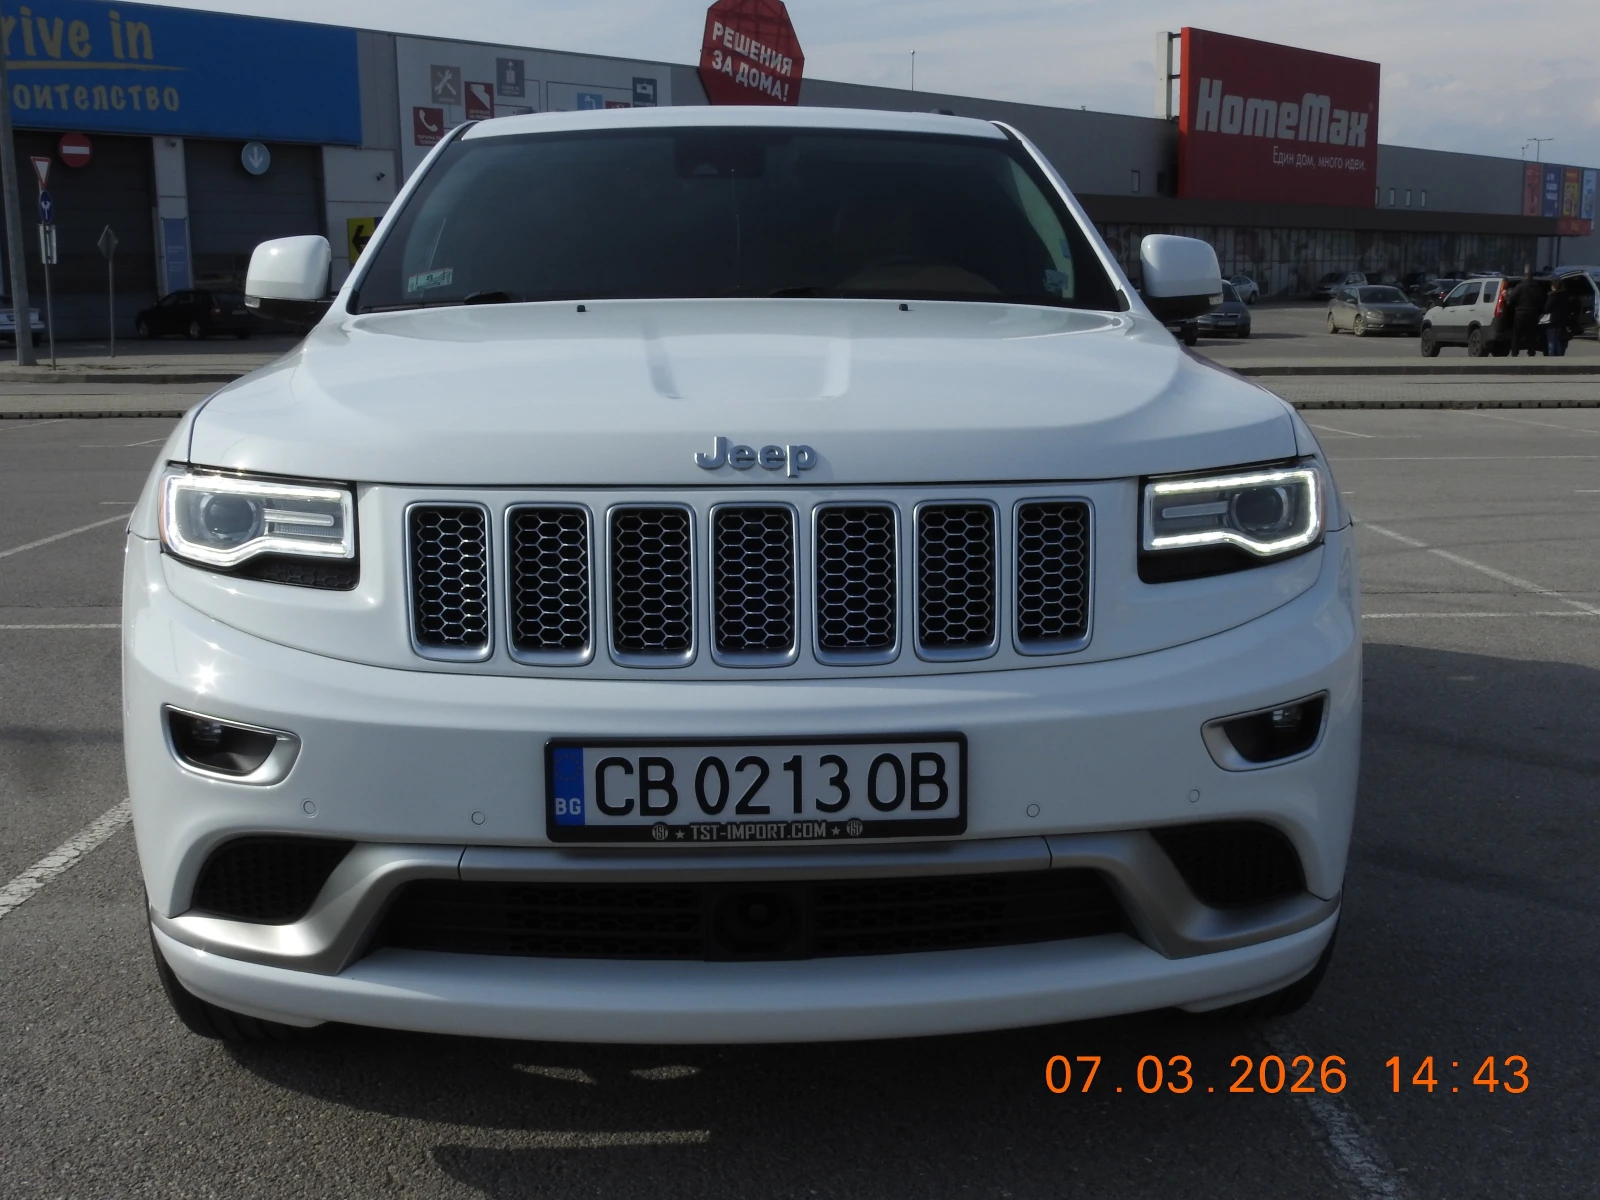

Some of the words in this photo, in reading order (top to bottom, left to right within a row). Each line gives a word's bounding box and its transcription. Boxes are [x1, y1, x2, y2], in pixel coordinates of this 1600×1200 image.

[109, 9, 154, 60] in
[712, 21, 793, 77] РЕШЕНИЯ
[712, 50, 733, 77] ЗА
[735, 61, 789, 102] ДОМА!
[1195, 77, 1369, 148] HomeMax
[1273, 146, 1294, 165] Един
[1296, 154, 1316, 170] дом,
[1318, 156, 1344, 170] много
[1345, 158, 1366, 172] идеи.
[693, 436, 817, 478] Jeep
[554, 797, 582, 816] BG
[595, 756, 679, 816] CB
[694, 754, 852, 816] 0213
[867, 752, 950, 813] OB
[690, 822, 827, 840] TST-IMPORT.COM
